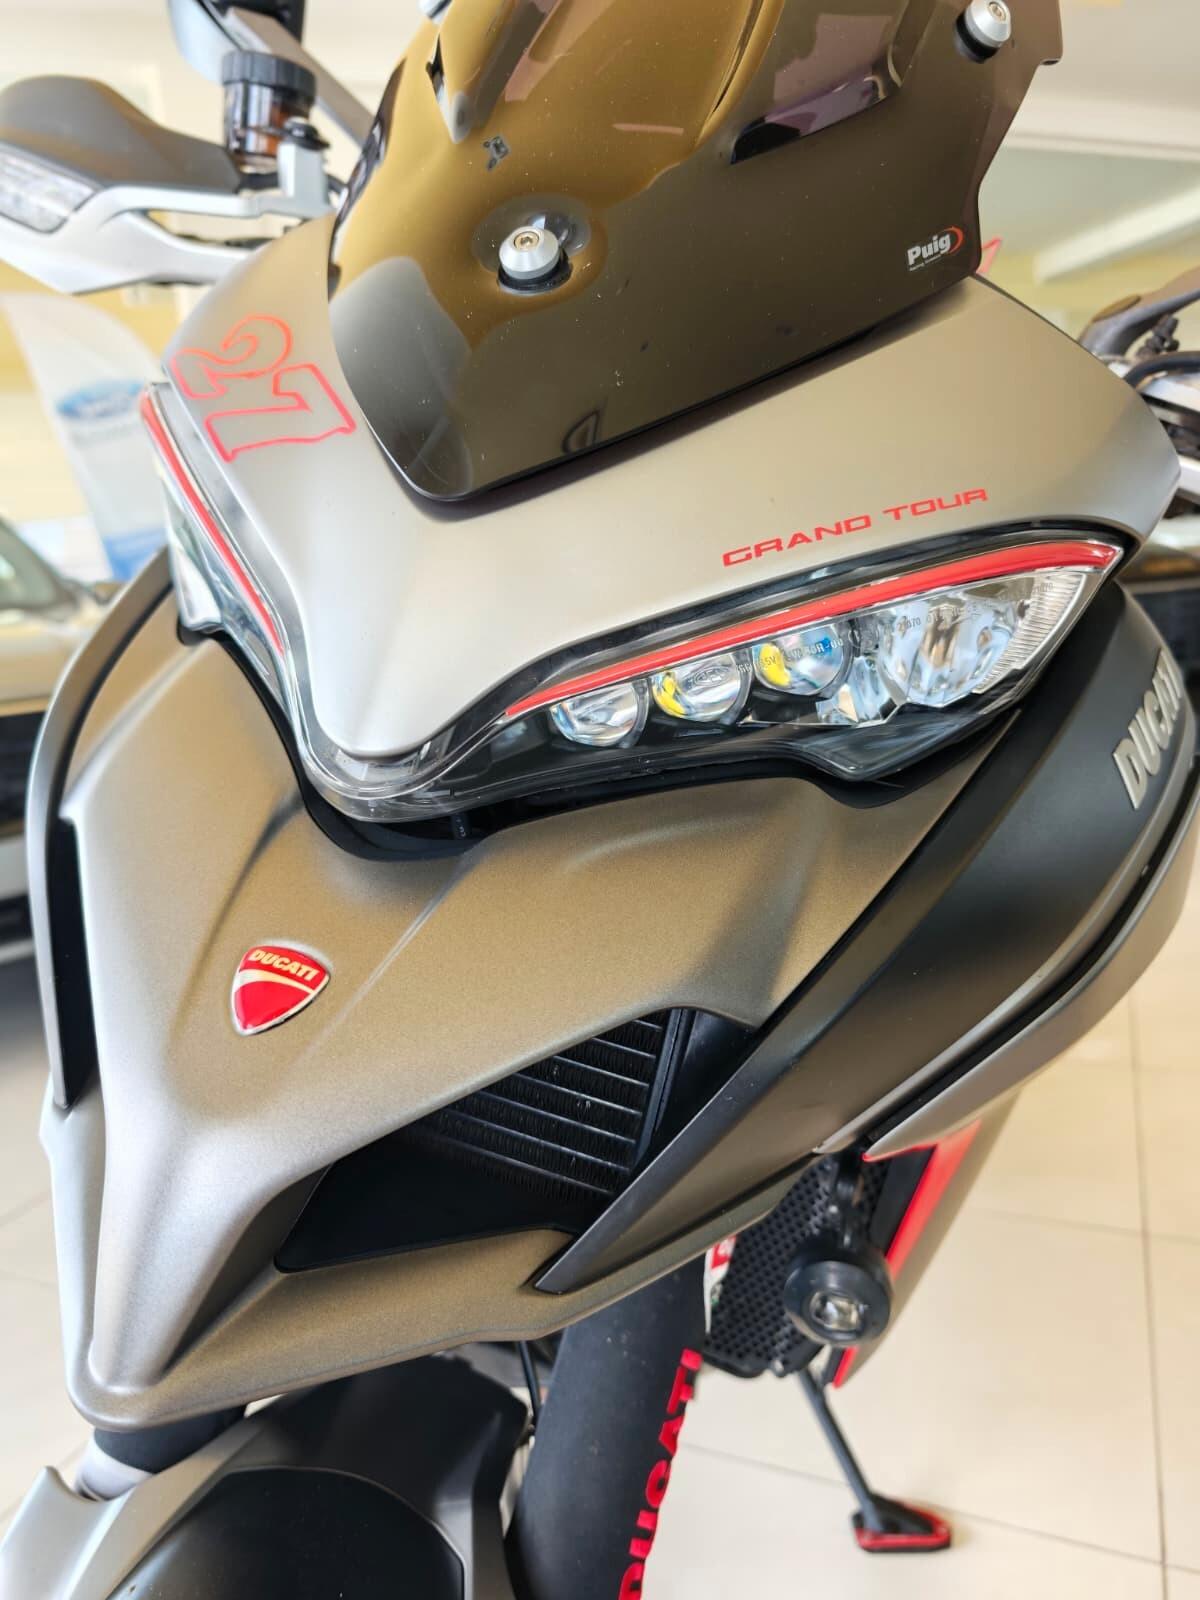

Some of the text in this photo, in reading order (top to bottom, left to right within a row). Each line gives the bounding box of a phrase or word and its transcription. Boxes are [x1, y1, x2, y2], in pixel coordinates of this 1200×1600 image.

[907, 233, 951, 266] Puig
[170, 313, 357, 463] 27
[722, 488, 988, 567] GRAND TOUR
[1112, 649, 1183, 811] DUCATI
[247, 949, 320, 982] DUCATI
